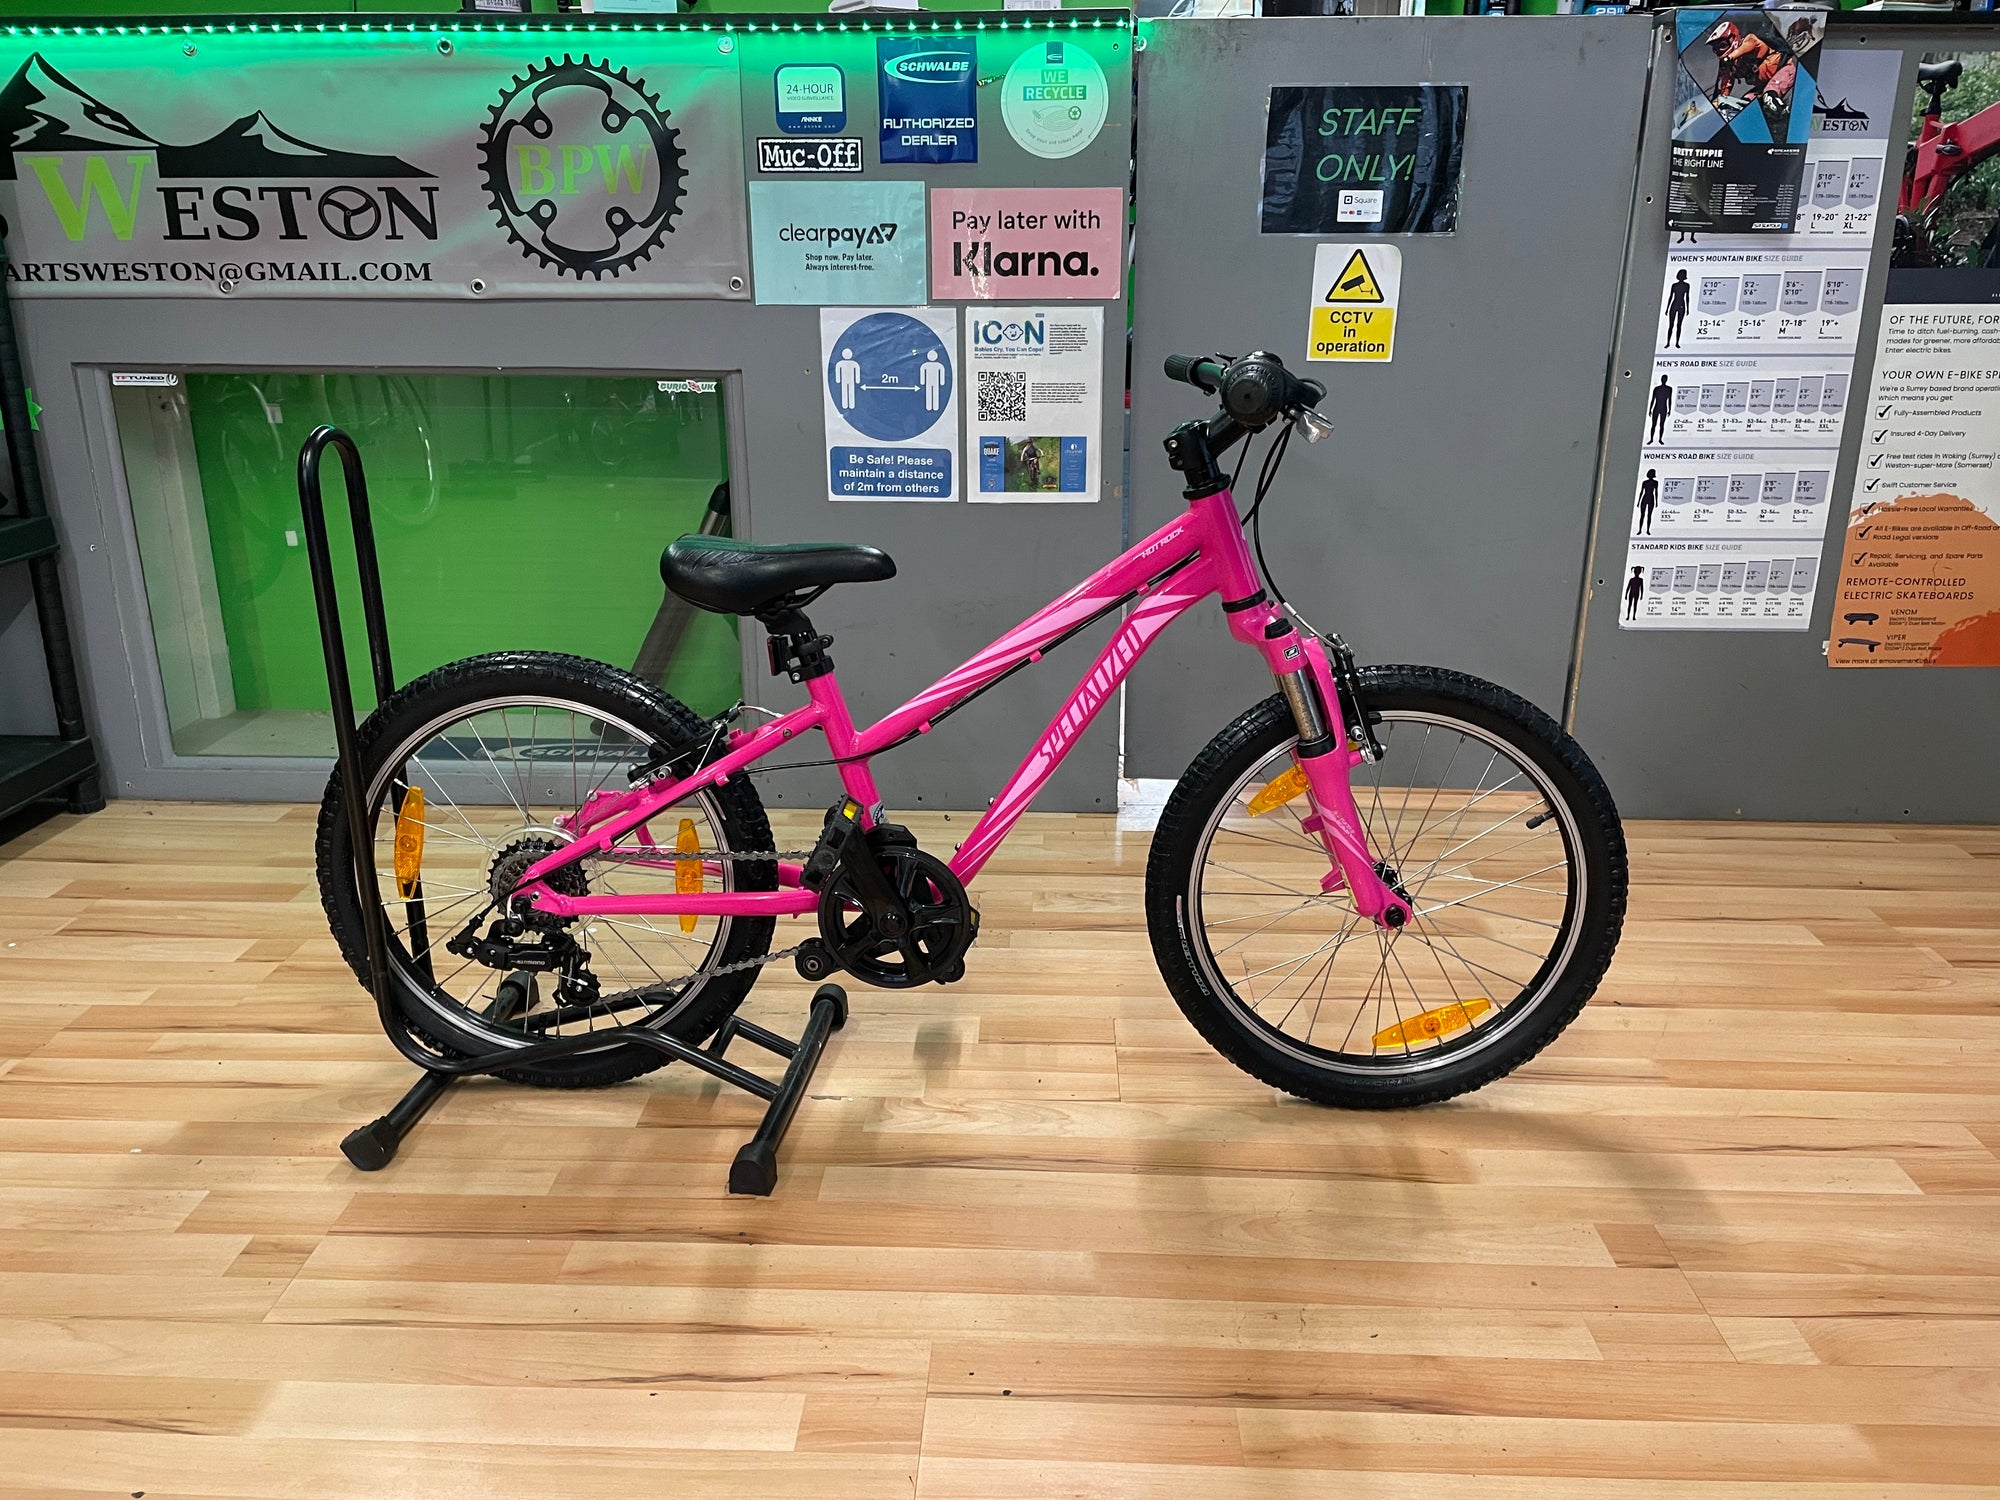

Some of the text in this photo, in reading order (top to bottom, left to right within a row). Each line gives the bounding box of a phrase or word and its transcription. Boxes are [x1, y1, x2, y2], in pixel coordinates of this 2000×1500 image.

[899, 60, 970, 73] SCHWALBE
[1044, 71, 1066, 83] WE
[786, 84, 834, 94] 24-HOUR
[1026, 87, 1084, 99] RECYCLE
[883, 118, 975, 130] AUTHORIZED
[1318, 108, 1422, 136] STAFF
[901, 134, 958, 146] DEALER
[763, 143, 857, 167] Muc-Off
[1673, 147, 1724, 158] BRETT TIPPIE
[1316, 154, 1416, 182] ONLY!
[1673, 158, 1724, 168] THE RIGHT LINE
[514, 144, 653, 196] BPW
[22, 155, 440, 241] WESTON
[1354, 196, 1378, 204] Square
[952, 209, 1101, 234] Pay later with
[779, 223, 866, 248] clearpay
[806, 253, 822, 262] Shop
[842, 254, 854, 262] Pay
[953, 242, 1099, 277] Klarna.
[806, 263, 829, 272] Always
[1330, 311, 1374, 324] CCTV
[1890, 314, 2000, 326] OF THE FUTURE, FOR
[1343, 326, 1356, 338] in
[1316, 340, 1386, 355] operation
[882, 374, 899, 384] 2m
[1882, 370, 1912, 380] YOUR
[1915, 370, 1944, 380] OWN
[1948, 370, 1982, 380] E-BIKE
[1894, 410, 1950, 418] Fully-Assembled
[850, 454, 934, 466] Be Safe! Please
[1968, 452, 1996, 460] (Surrey)
[1954, 461, 1992, 469] (Somerset)
[839, 468, 886, 478] maintain
[898, 469, 944, 480] distance
[844, 482, 940, 493] of 2m from others
[1846, 577, 1966, 586] REMOTE-CONTROLLED
[1844, 592, 1974, 600] ELECTRIC SKATEBOARDS
[527, 748, 649, 758] SCHWAL
